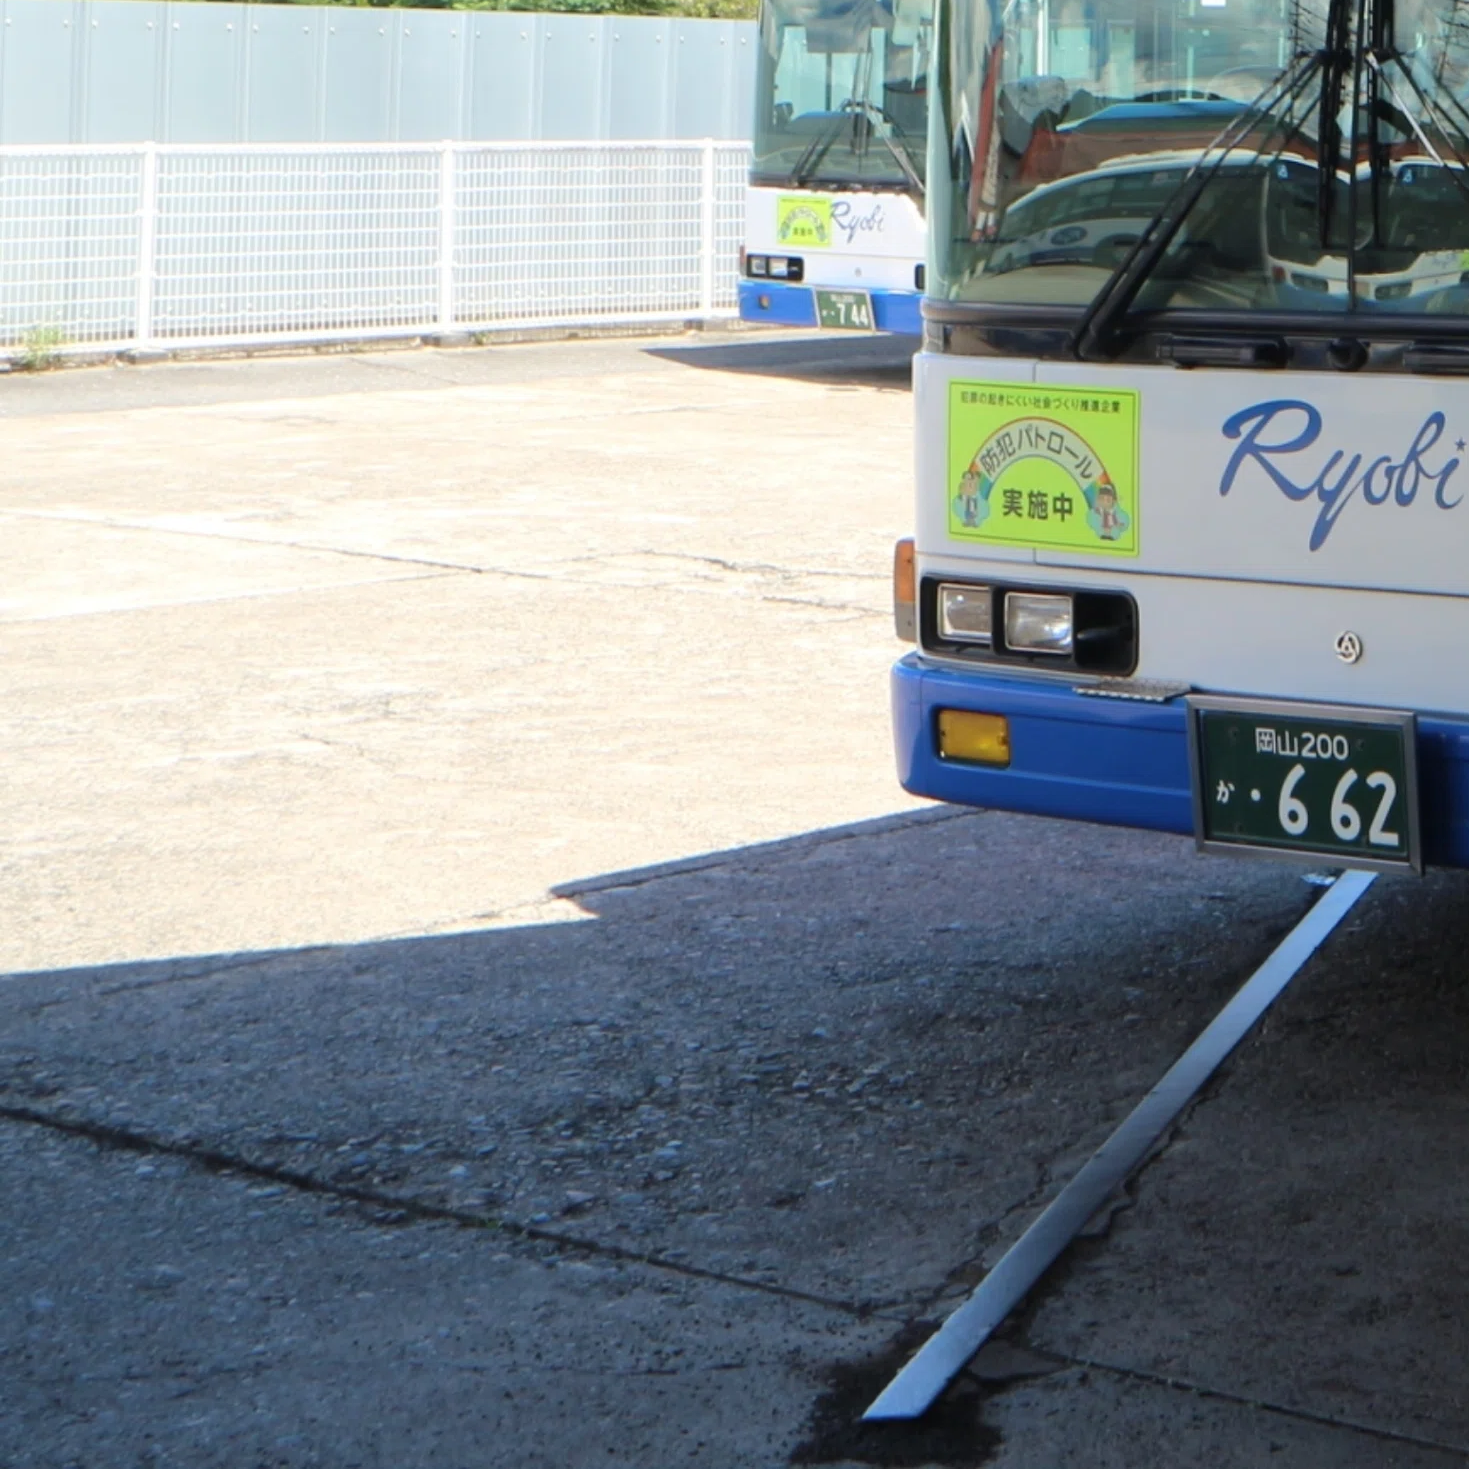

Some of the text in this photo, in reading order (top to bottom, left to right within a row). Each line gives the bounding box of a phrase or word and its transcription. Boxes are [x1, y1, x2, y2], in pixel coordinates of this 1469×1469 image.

[831, 201, 887, 244] Ryobi
[979, 423, 1093, 480] 防犯パトロール
[1219, 398, 1466, 551] Ryobi
[1002, 488, 1074, 523] 実施中
[1255, 727, 1349, 761] 岡山200
[1216, 779, 1235, 804] か
